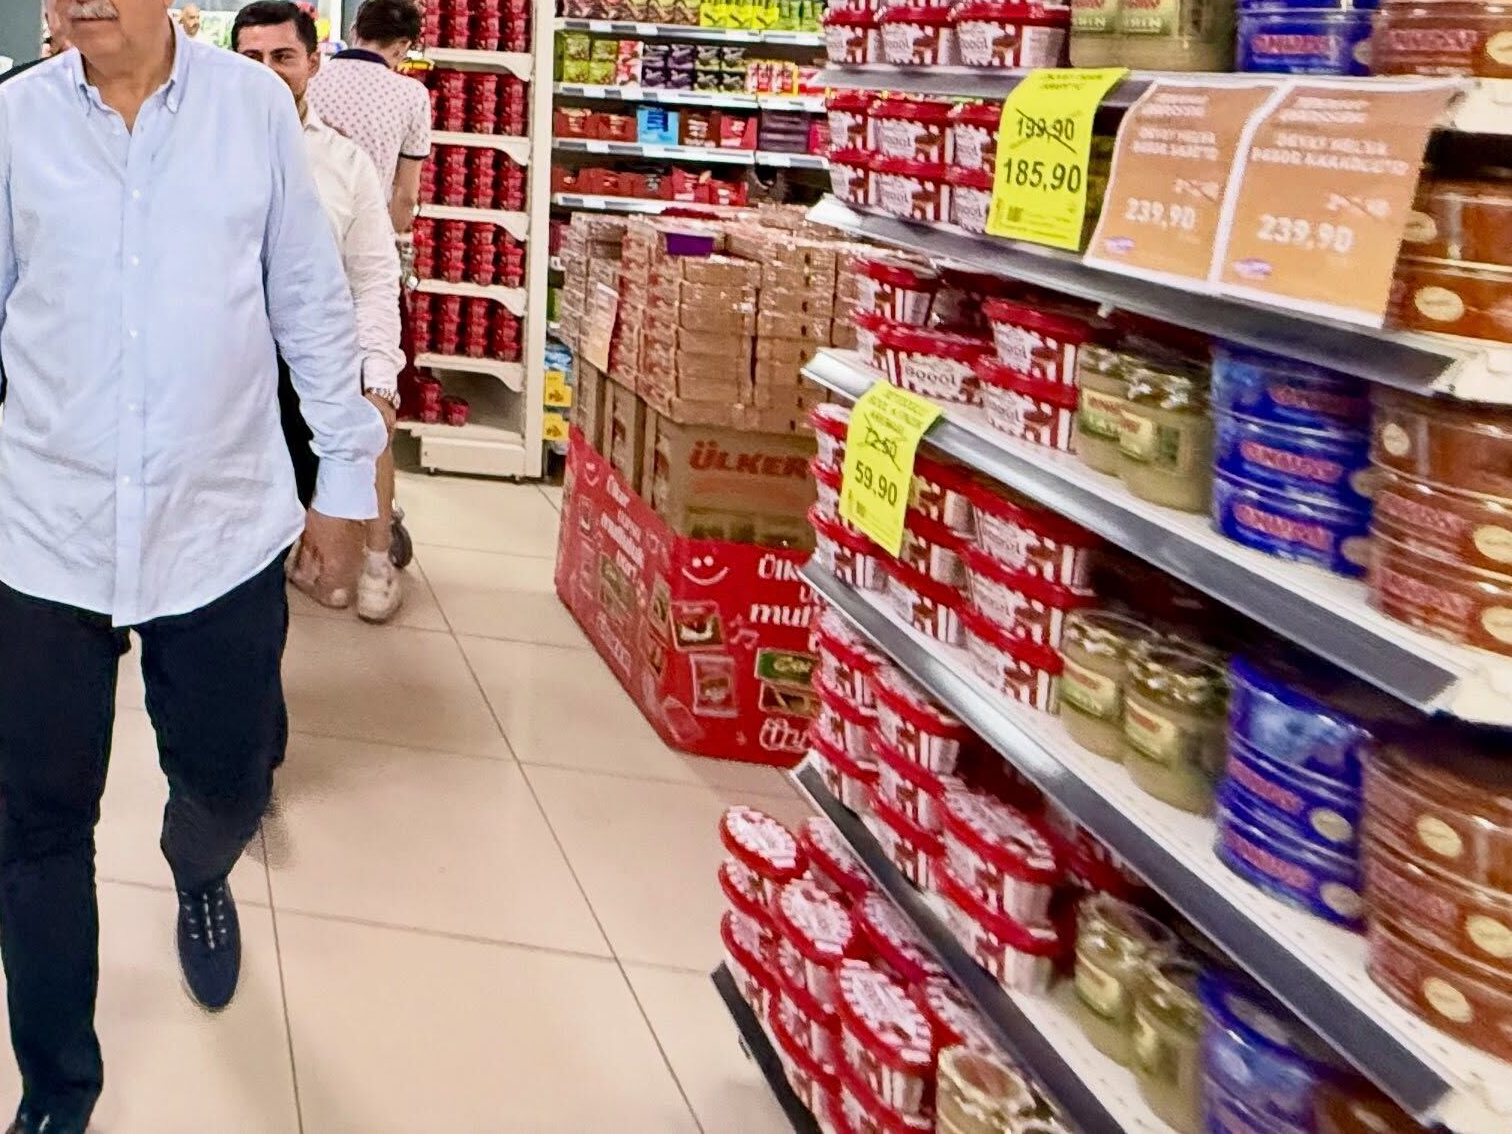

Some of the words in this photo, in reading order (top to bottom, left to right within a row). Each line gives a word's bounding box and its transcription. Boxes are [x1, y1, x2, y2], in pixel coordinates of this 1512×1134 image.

[1003, 157, 1083, 195] 185,90
[1125, 196, 1198, 232] 239,90
[1256, 212, 1355, 255] 239,90
[690, 440, 808, 480] ÜLKER
